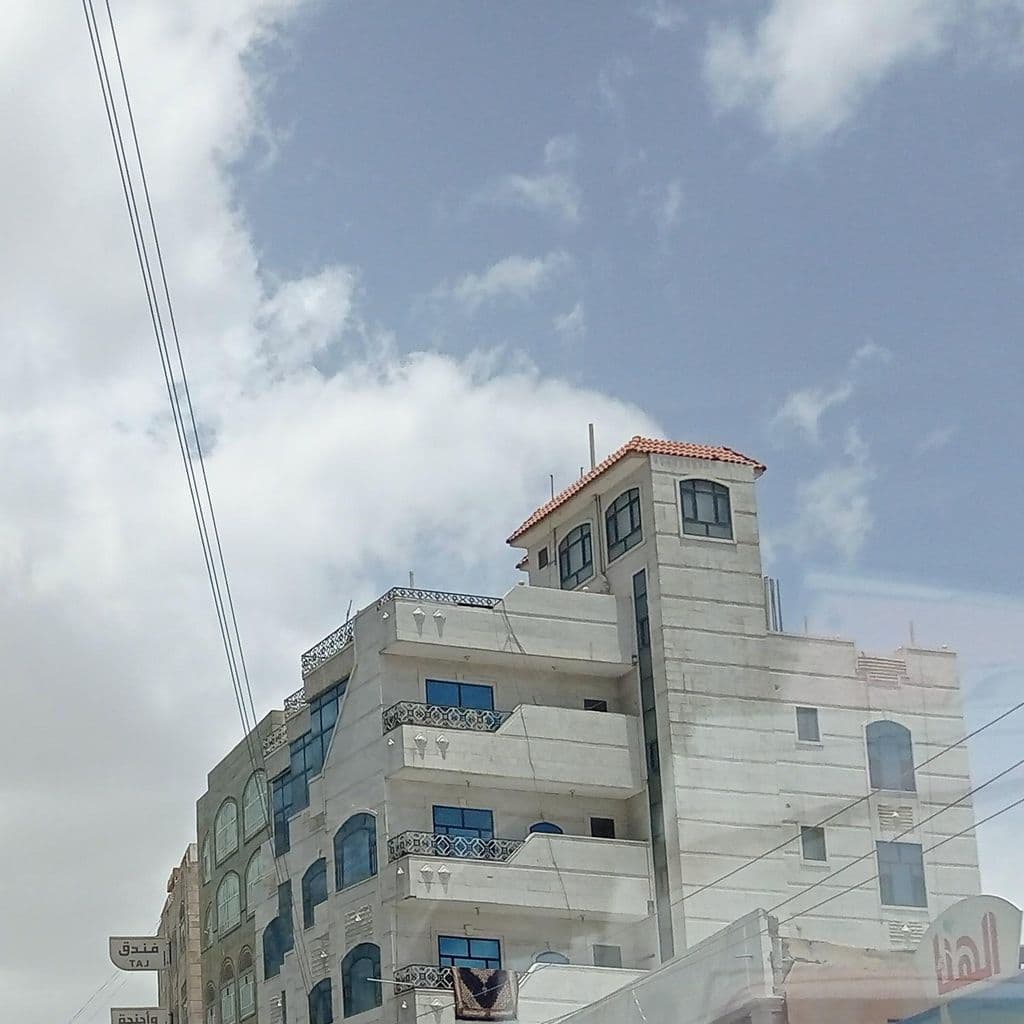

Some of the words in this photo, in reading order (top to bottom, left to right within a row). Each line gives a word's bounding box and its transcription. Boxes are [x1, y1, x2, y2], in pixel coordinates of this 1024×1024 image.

[118, 942, 160, 957] فندق
[932, 911, 1001, 996] الهنا
[128, 959, 150, 968] TAJ
